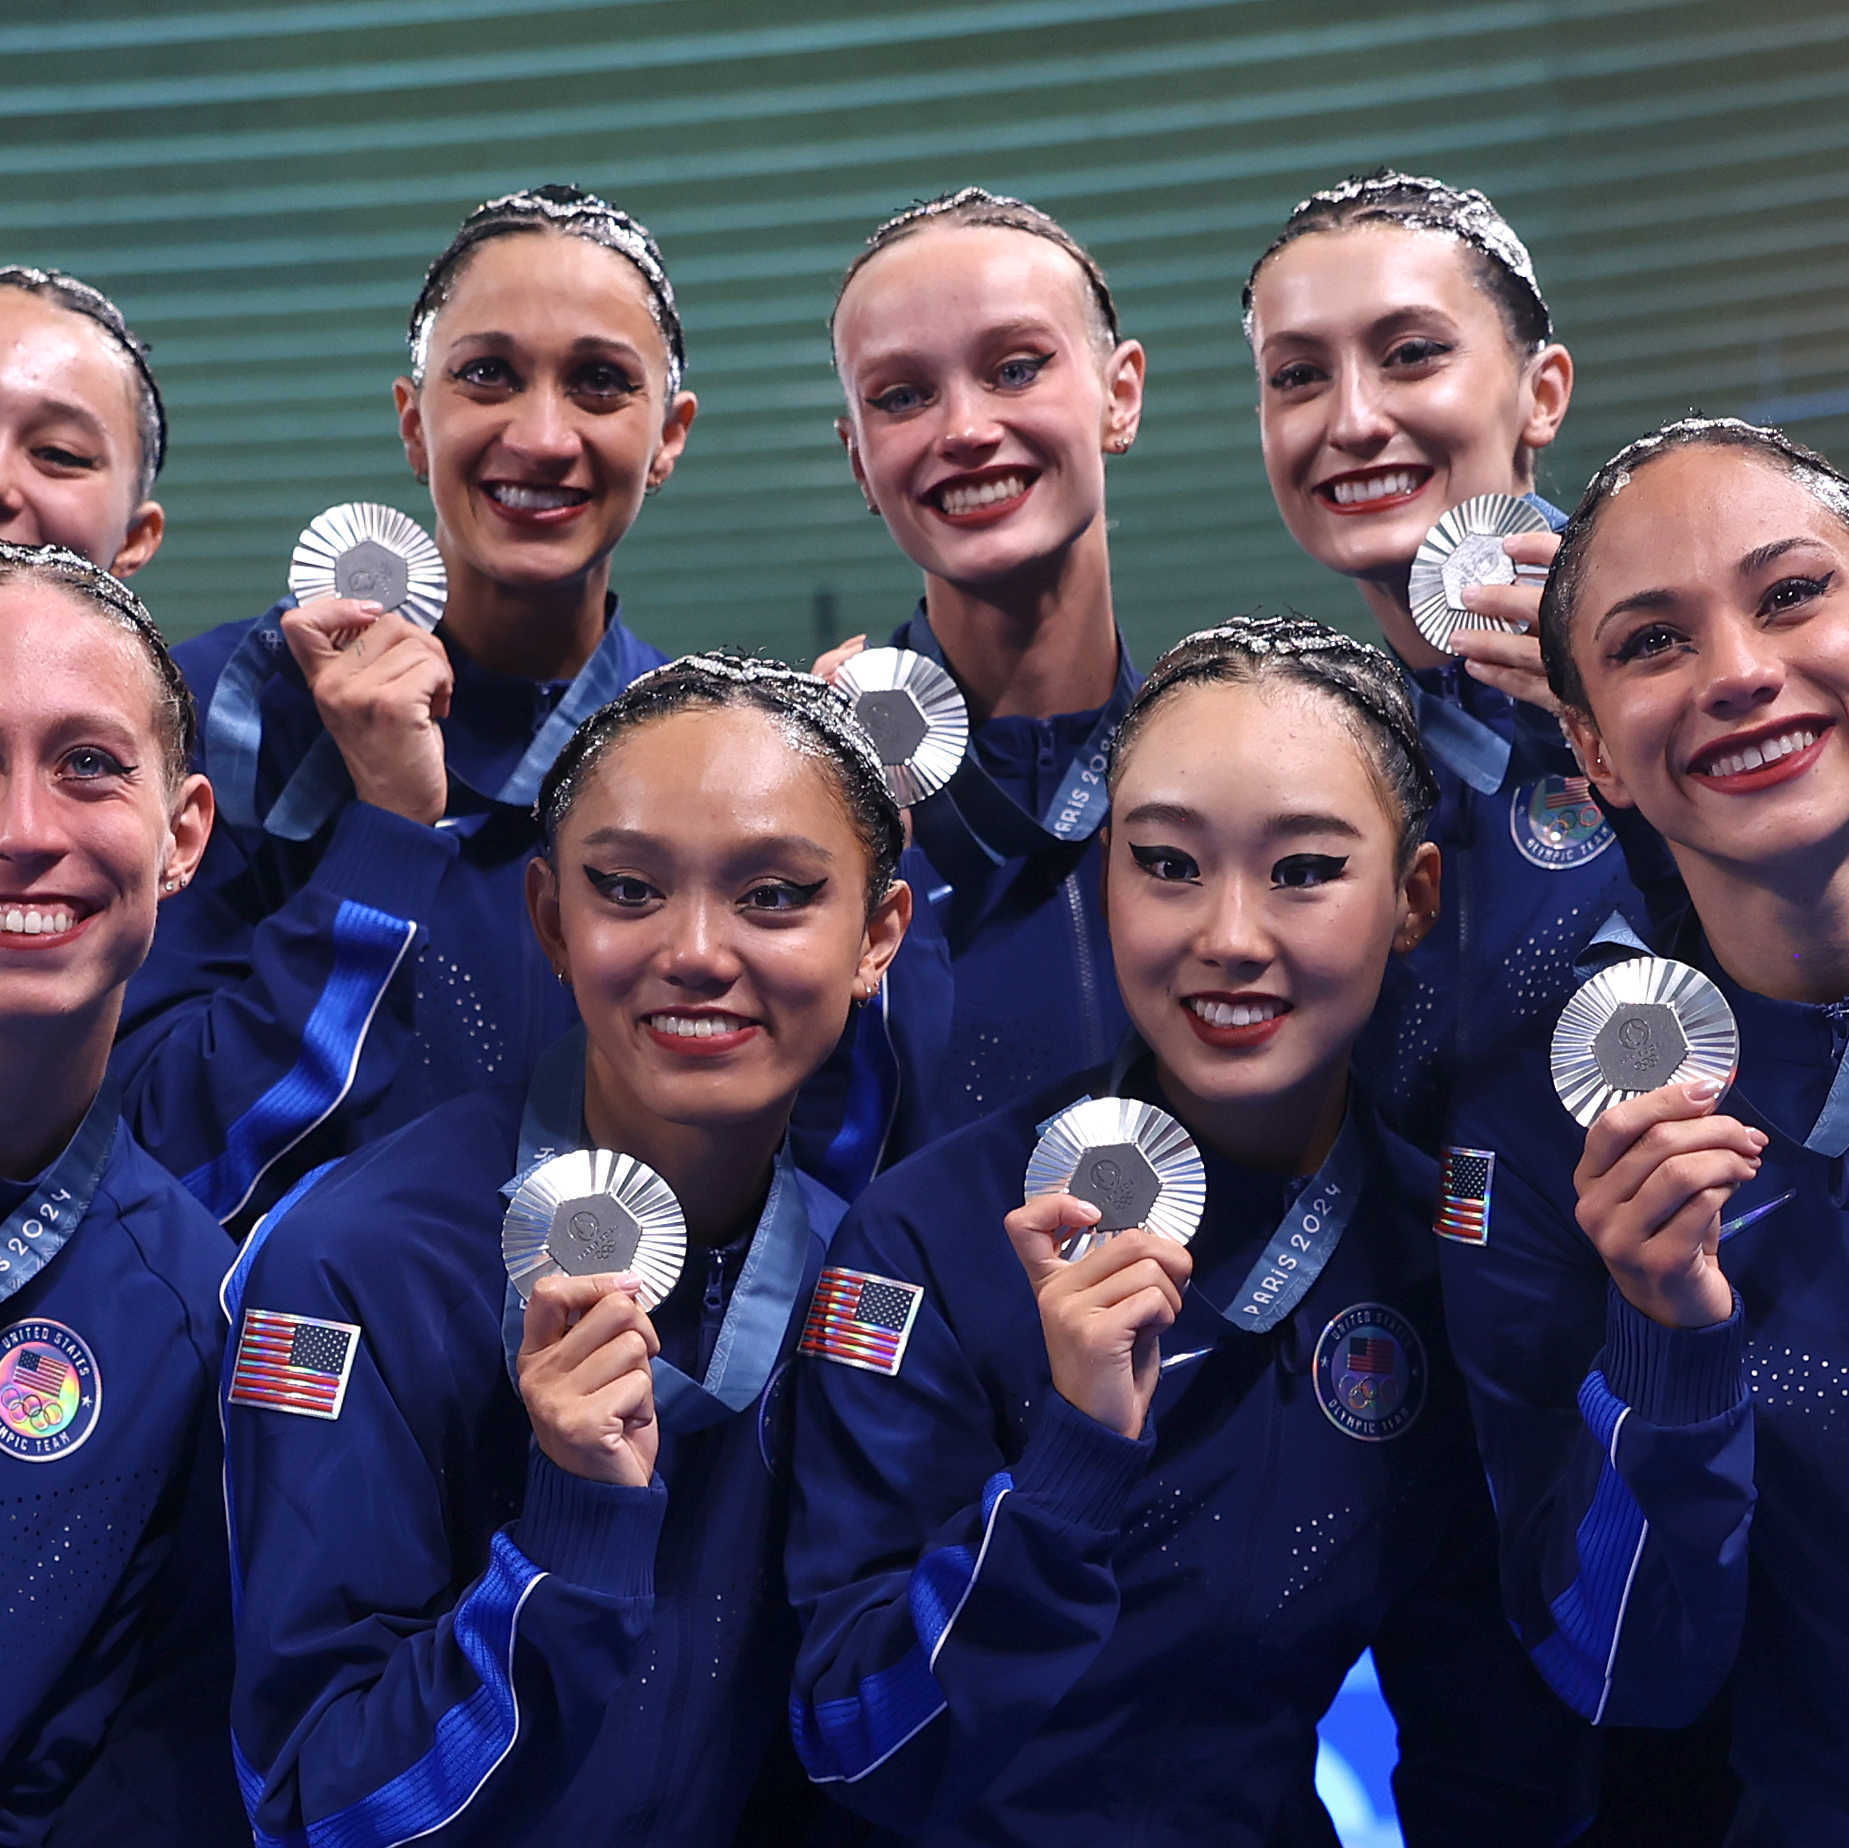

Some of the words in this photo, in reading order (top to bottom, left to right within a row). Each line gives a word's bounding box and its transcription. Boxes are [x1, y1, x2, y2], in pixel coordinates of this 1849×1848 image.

[1054, 788, 1090, 841] ARiS
[1526, 838, 1573, 861] OLYMPIC
[7, 1188, 72, 1257] 2024
[1290, 1183, 1341, 1252] 2024
[1331, 1310, 1371, 1340] UNITED
[1375, 1312, 1414, 1347] STAT
[2, 1326, 49, 1349] UNITED
[54, 1334, 90, 1376] STATES
[1328, 1399, 1375, 1434] OLYMPIC
[36, 1432, 70, 1452] TEAM
